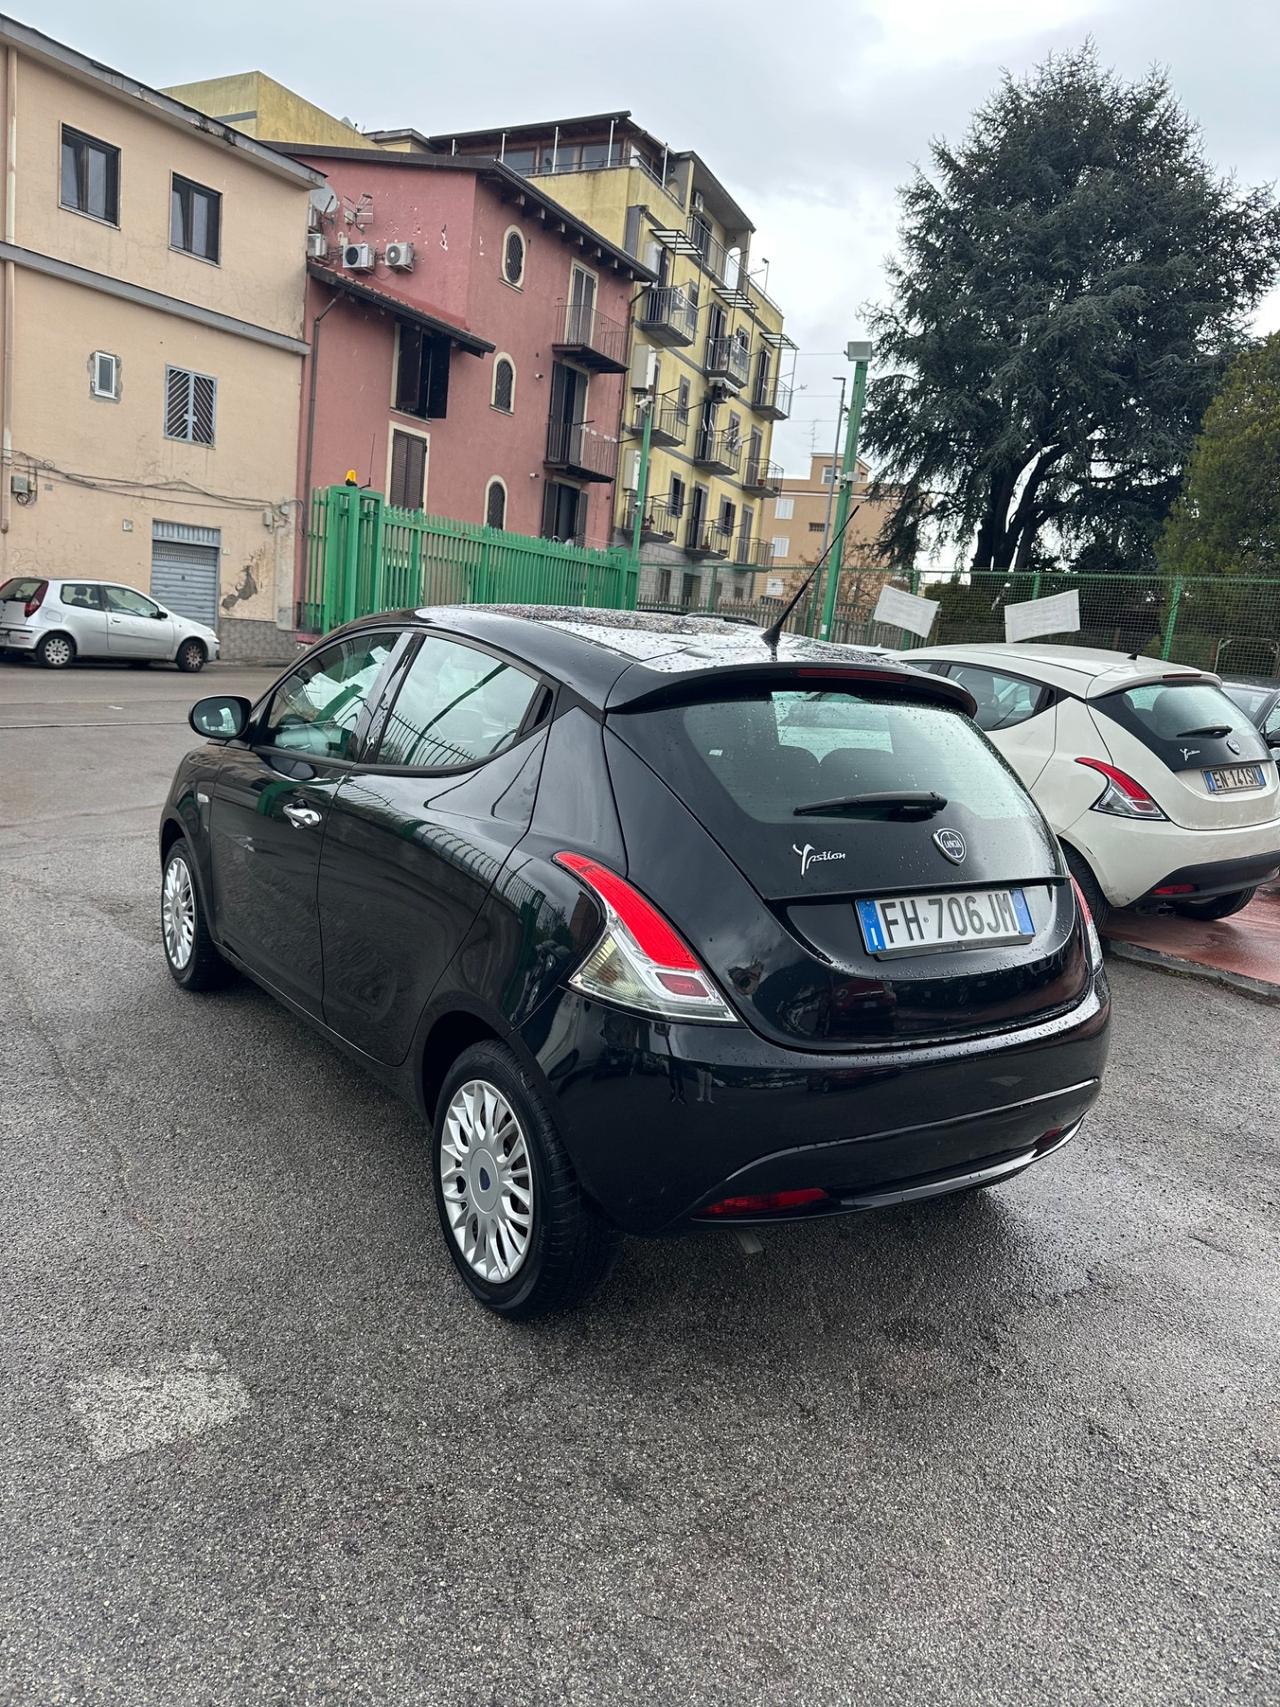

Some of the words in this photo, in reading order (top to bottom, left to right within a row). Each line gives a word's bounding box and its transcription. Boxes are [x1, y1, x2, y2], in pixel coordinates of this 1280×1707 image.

[1212, 770, 1229, 789] EN
[943, 840, 962, 849] LANCIA
[792, 843, 846, 876] Ypsilon
[879, 899, 925, 944] FH
[928, 892, 1018, 939] 706JM
